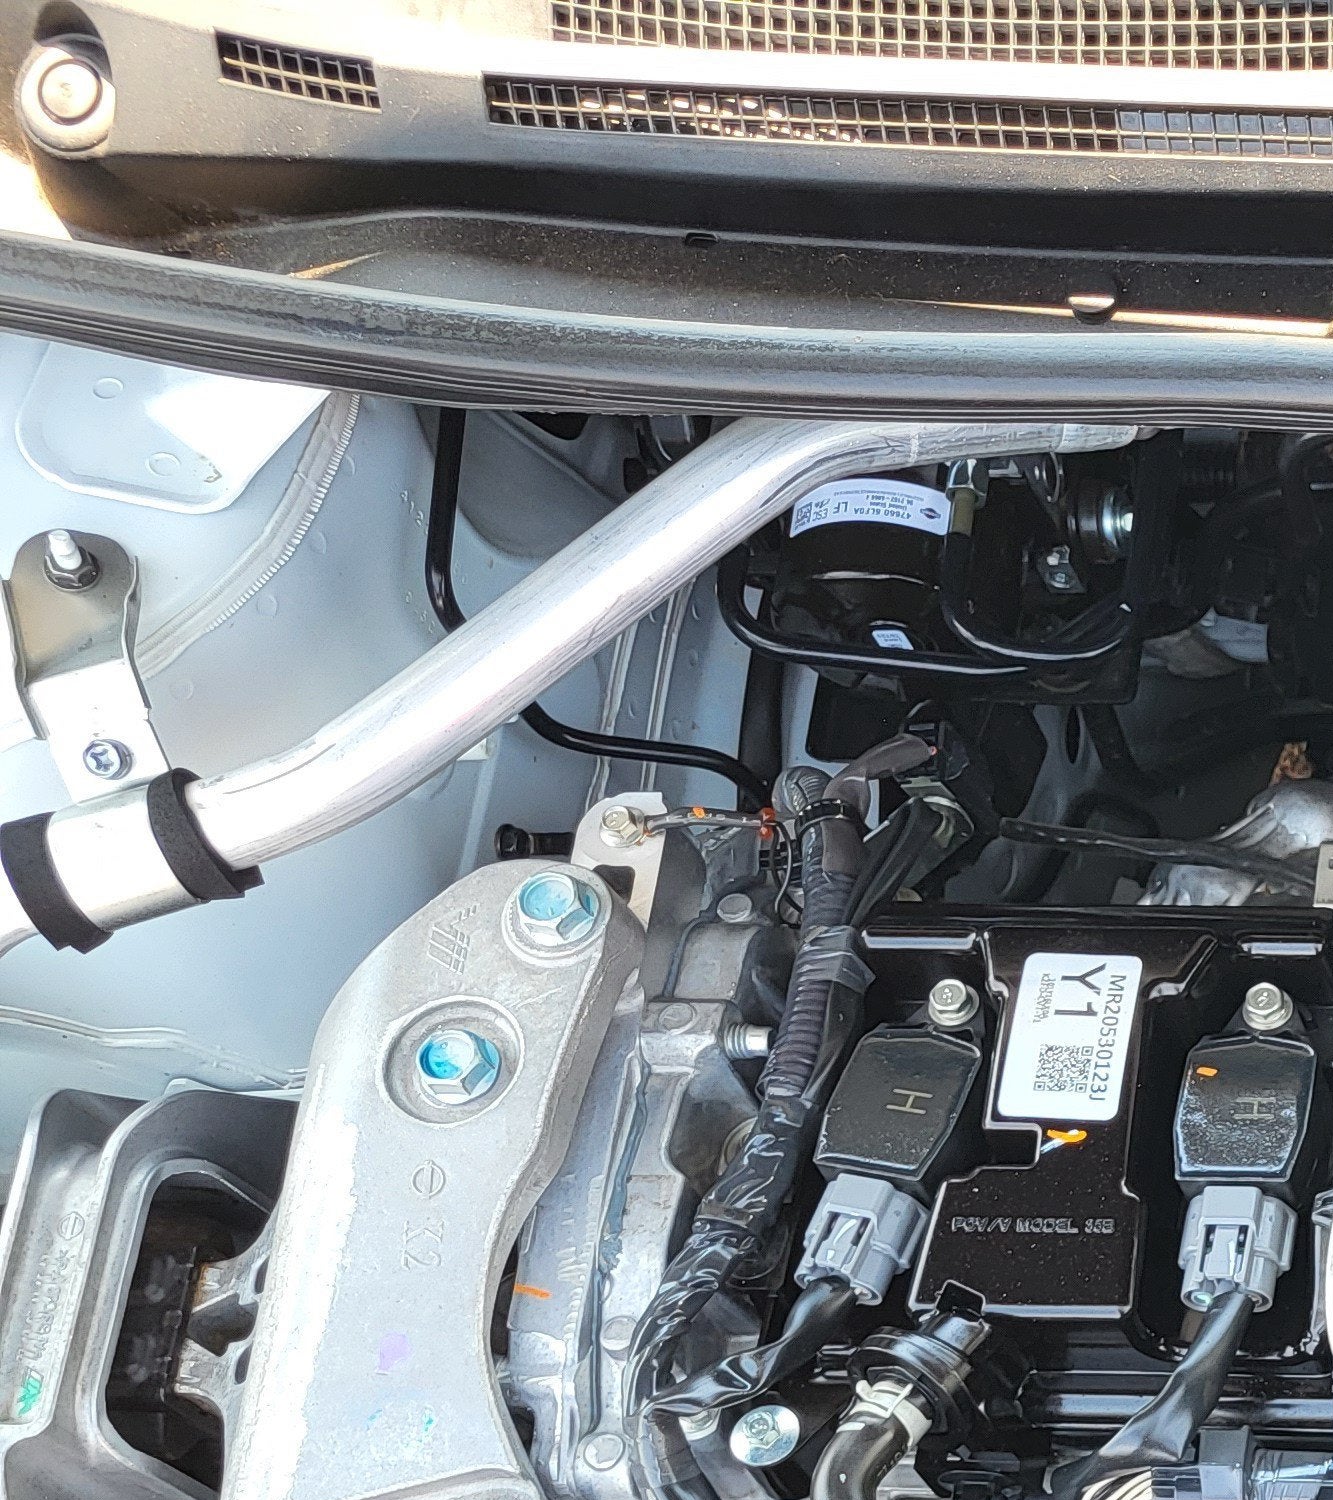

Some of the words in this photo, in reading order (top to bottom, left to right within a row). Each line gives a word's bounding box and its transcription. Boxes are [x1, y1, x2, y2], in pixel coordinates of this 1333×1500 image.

[1054, 963, 1107, 1017] Y1
[1088, 975, 1127, 1101] MR20530123J
[1015, 1217, 1079, 1234] MODEL
